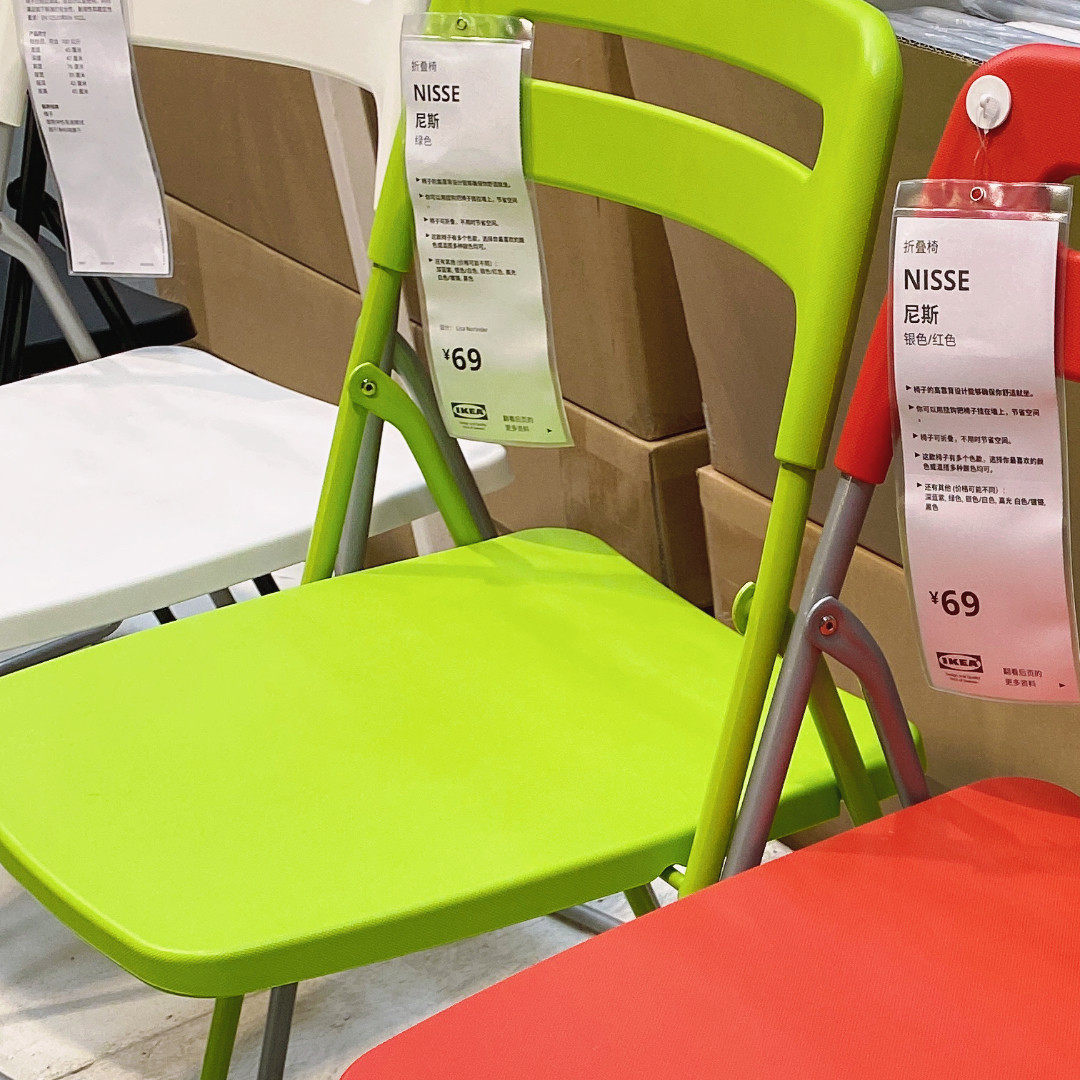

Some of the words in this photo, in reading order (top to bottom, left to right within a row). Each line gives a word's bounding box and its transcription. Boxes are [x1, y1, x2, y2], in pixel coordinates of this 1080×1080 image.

[411, 60, 437, 72] 折叠椅
[413, 84, 460, 102] NISSE
[415, 112, 439, 129] 尼斯
[415, 135, 432, 147] 绿色
[903, 239, 939, 254] 折叠椅
[904, 268, 970, 291] NISSE
[903, 304, 939, 325] 尼斯
[903, 332, 957, 347] 银色/红色
[442, 347, 482, 371] ¥69
[455, 407, 484, 415] IKEA
[929, 589, 980, 617] ¥69
[941, 656, 980, 668] IKEA
